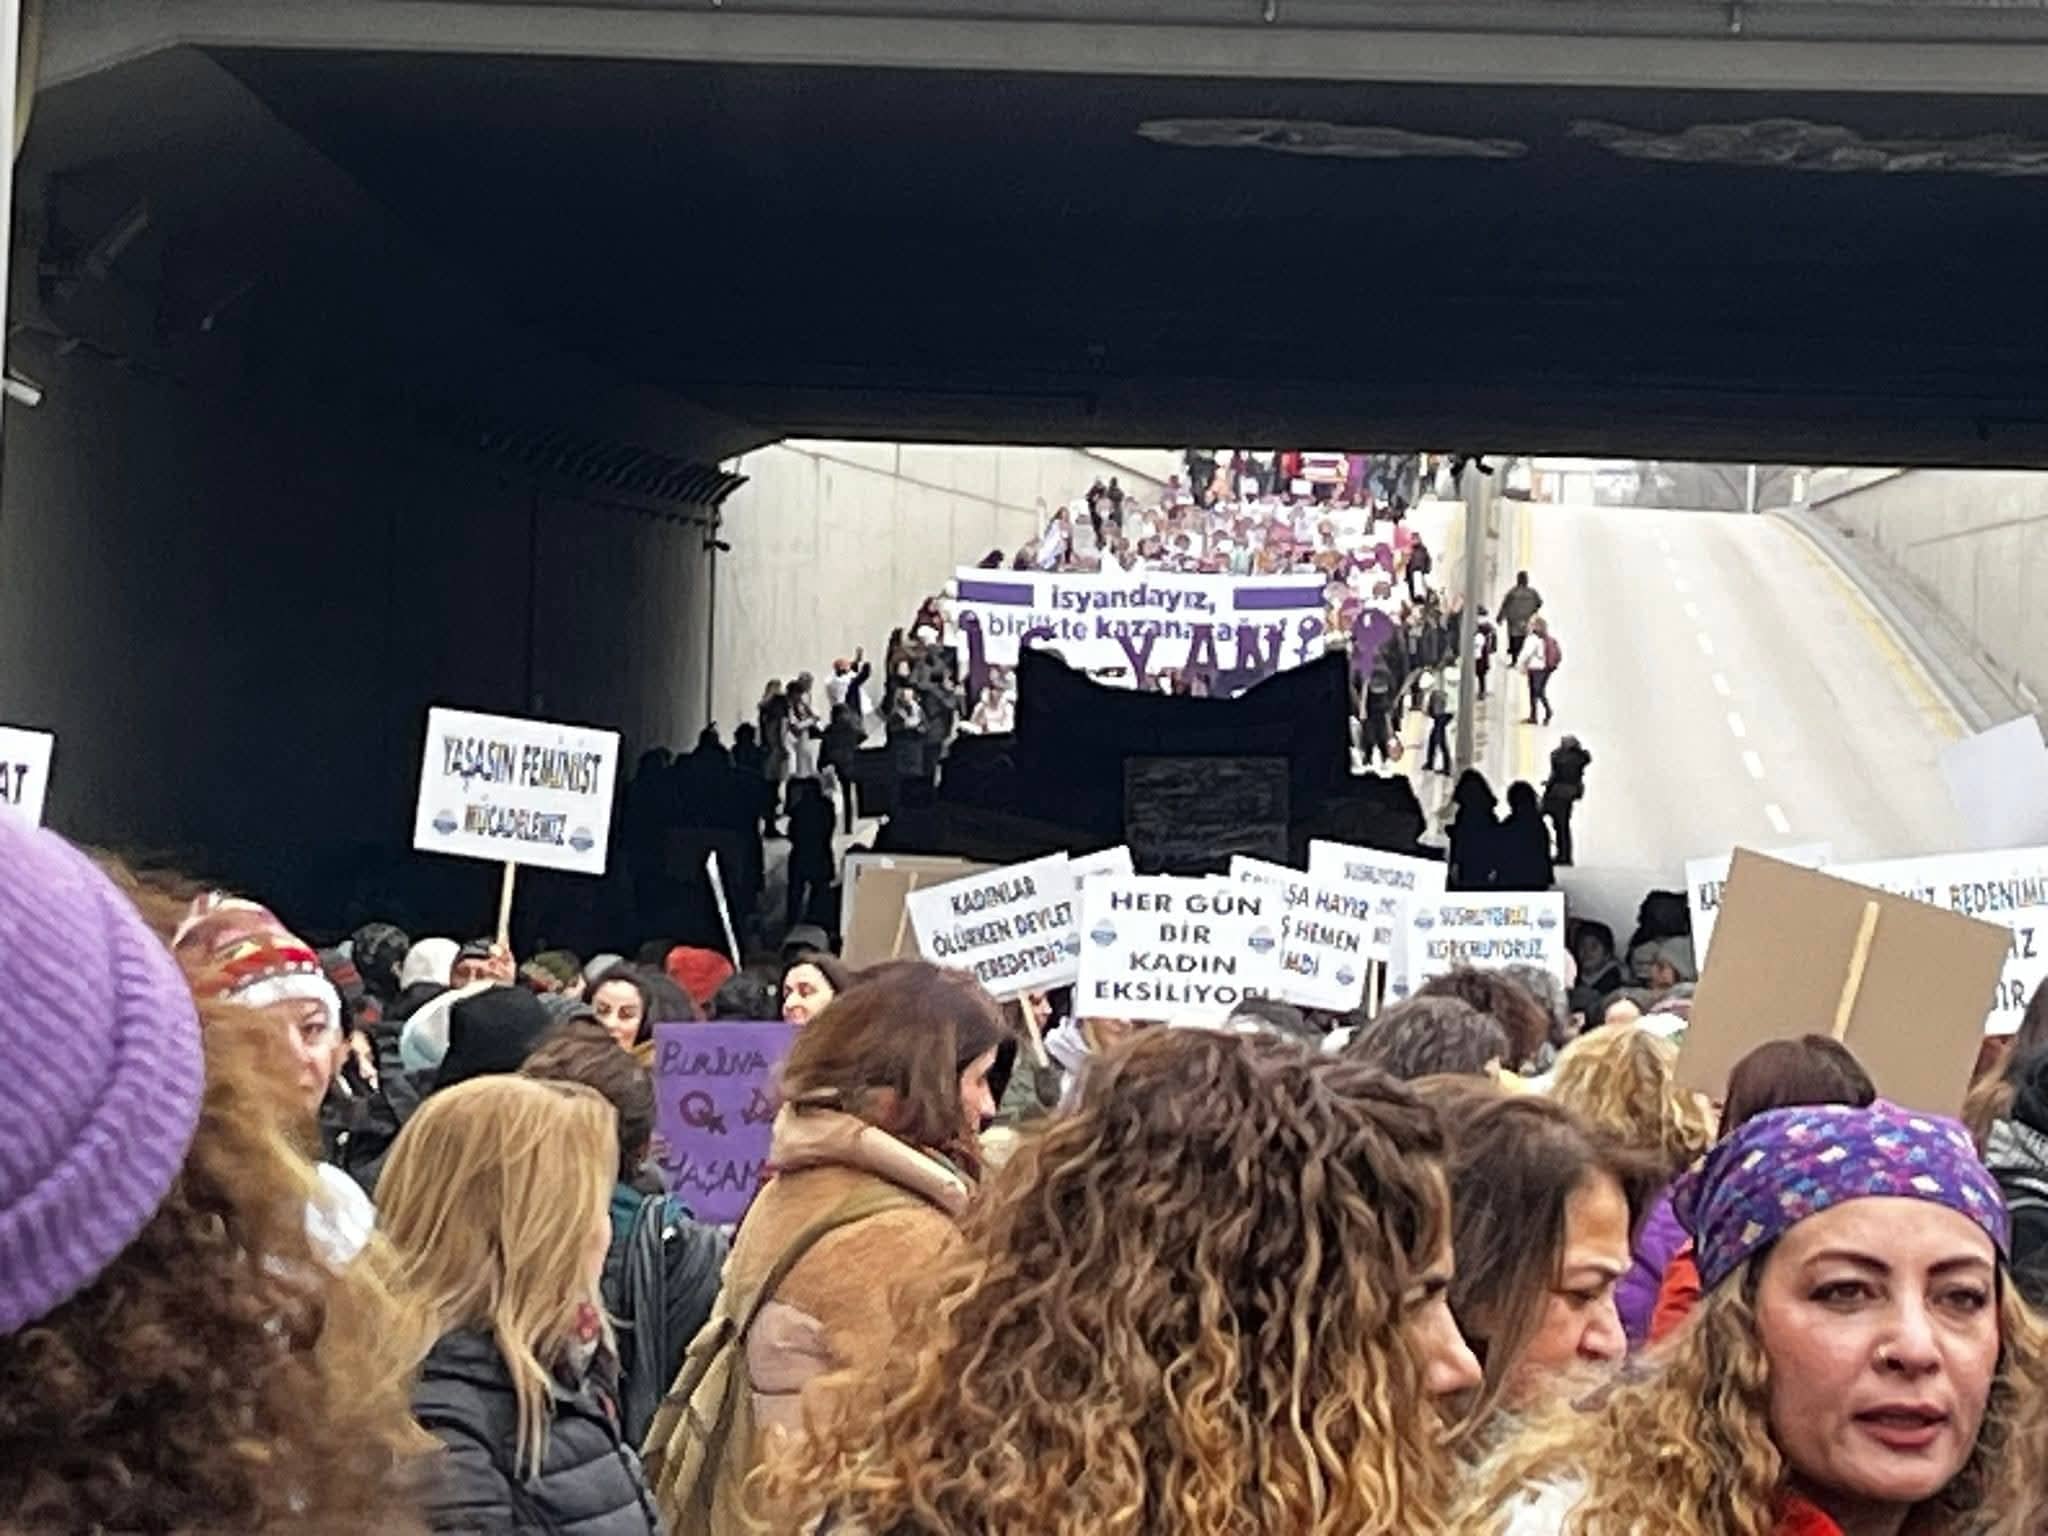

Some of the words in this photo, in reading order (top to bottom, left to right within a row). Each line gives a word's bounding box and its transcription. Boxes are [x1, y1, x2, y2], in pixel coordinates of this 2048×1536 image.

[951, 876, 1036, 915] KADINLAR
[1111, 891, 1172, 912] HER
[1186, 889, 1262, 916] GÜN
[933, 918, 1012, 957] ÖLÜRKEN
[1014, 901, 1072, 937] DEVLET
[1160, 921, 1211, 944] BİR
[970, 939, 1064, 982] EREDEYDİ?
[1129, 952, 1237, 975] KADIN
